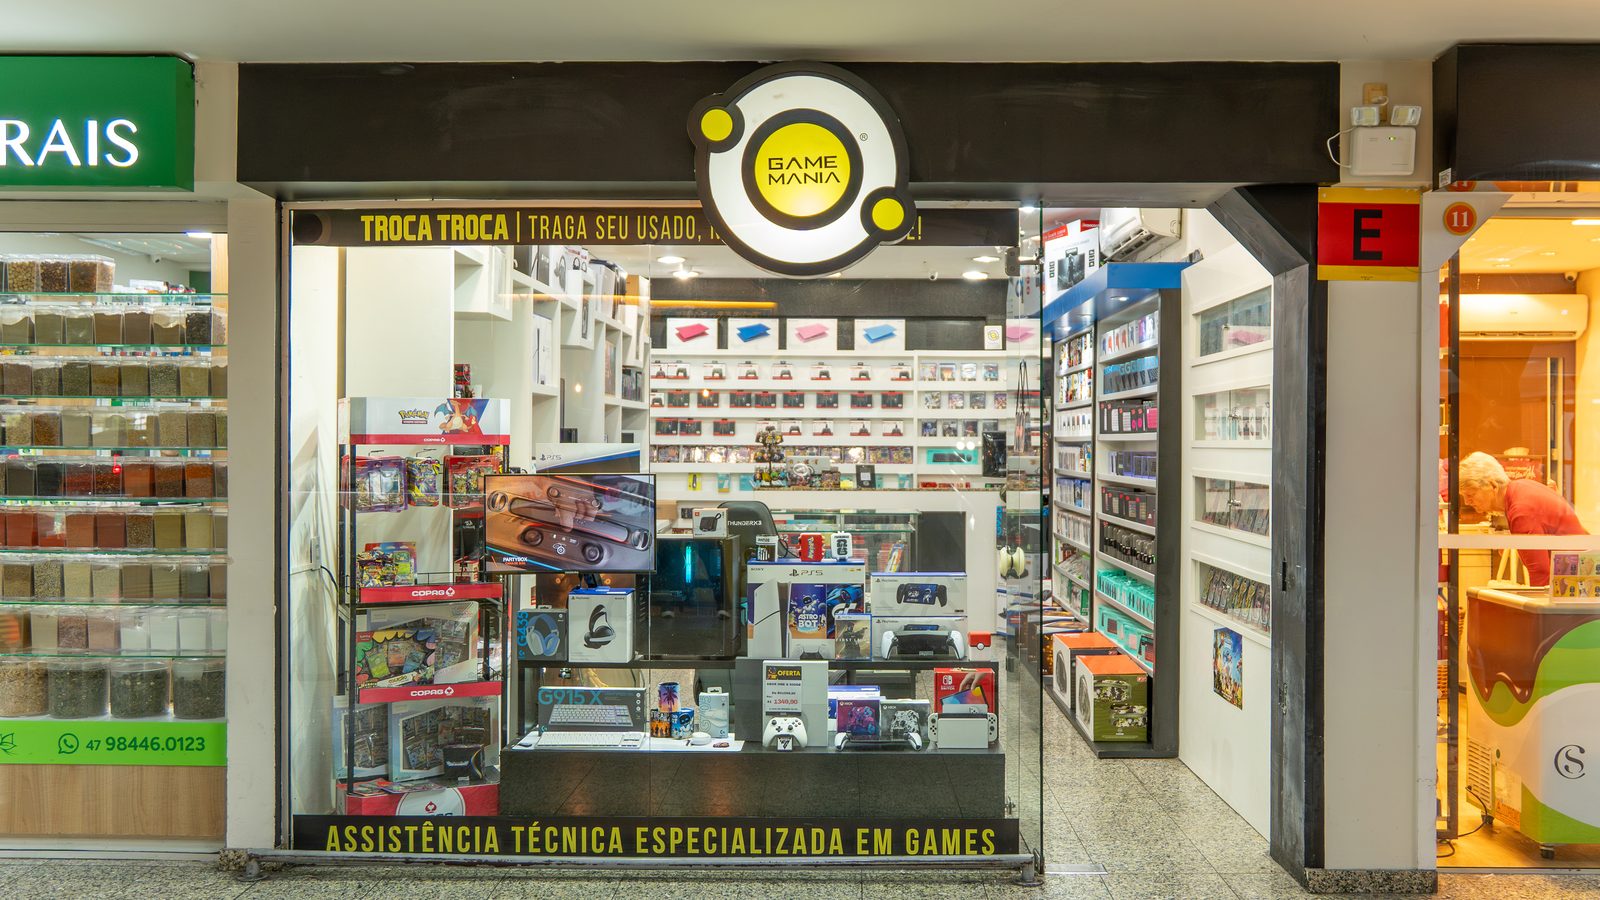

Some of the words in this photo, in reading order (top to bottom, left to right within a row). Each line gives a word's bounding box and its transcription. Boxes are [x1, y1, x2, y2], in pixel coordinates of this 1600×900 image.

[768, 155, 838, 171] GAME
[768, 171, 841, 186] MANIA
[1451, 210, 1469, 228] 11
[361, 214, 433, 242] TROCA
[436, 213, 509, 241] TROCA
[528, 214, 588, 241] TRAGA
[595, 214, 629, 240] SEU
[637, 214, 702, 243] USADO,
[1352, 208, 1383, 261] E
[411, 589, 445, 597] COPAG
[516, 611, 529, 647] G435
[798, 619, 819, 628] BOT
[410, 689, 444, 697] COPAG
[537, 689, 586, 705] G915
[589, 689, 604, 705] X
[86, 739, 102, 751] 47
[105, 737, 206, 752] 98446.0123
[326, 820, 499, 853] ASSISTÊNCIA
[511, 821, 623, 854] TÉCNICA
[636, 826, 844, 855] ESPECIALIZADA
[856, 828, 892, 855] EM
[905, 828, 995, 856] GAMES
